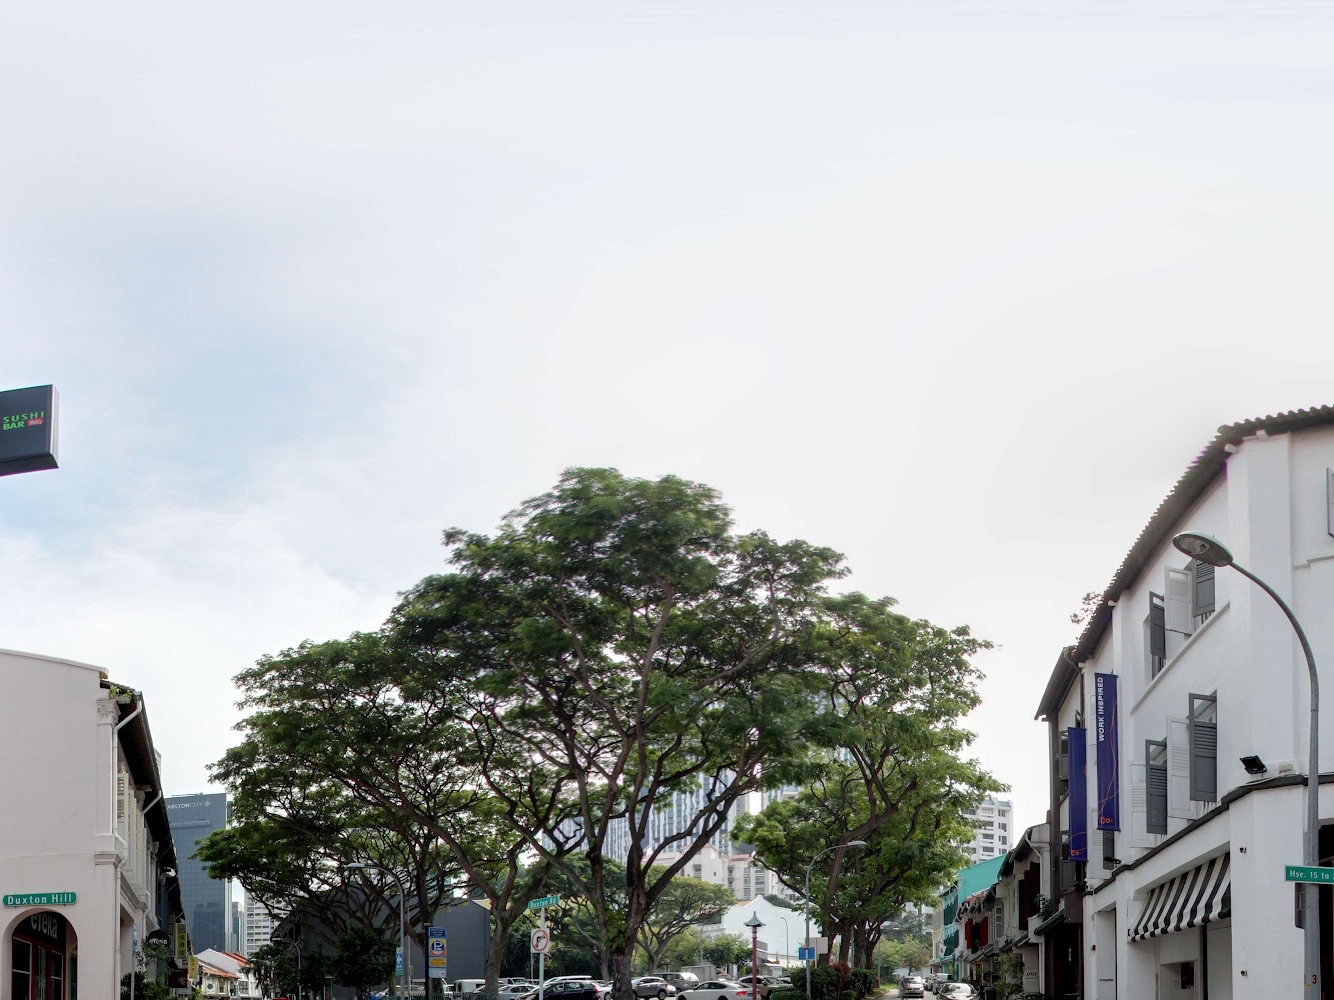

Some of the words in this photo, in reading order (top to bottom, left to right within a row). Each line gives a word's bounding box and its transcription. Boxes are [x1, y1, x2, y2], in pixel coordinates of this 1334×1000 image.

[3, 411, 44, 424] SUSHI
[3, 421, 25, 431] BAR
[1310, 871, 1318, 879] 15
[1321, 872, 1330, 880] to
[8, 895, 47, 905] Duxton
[51, 893, 72, 903] Hill
